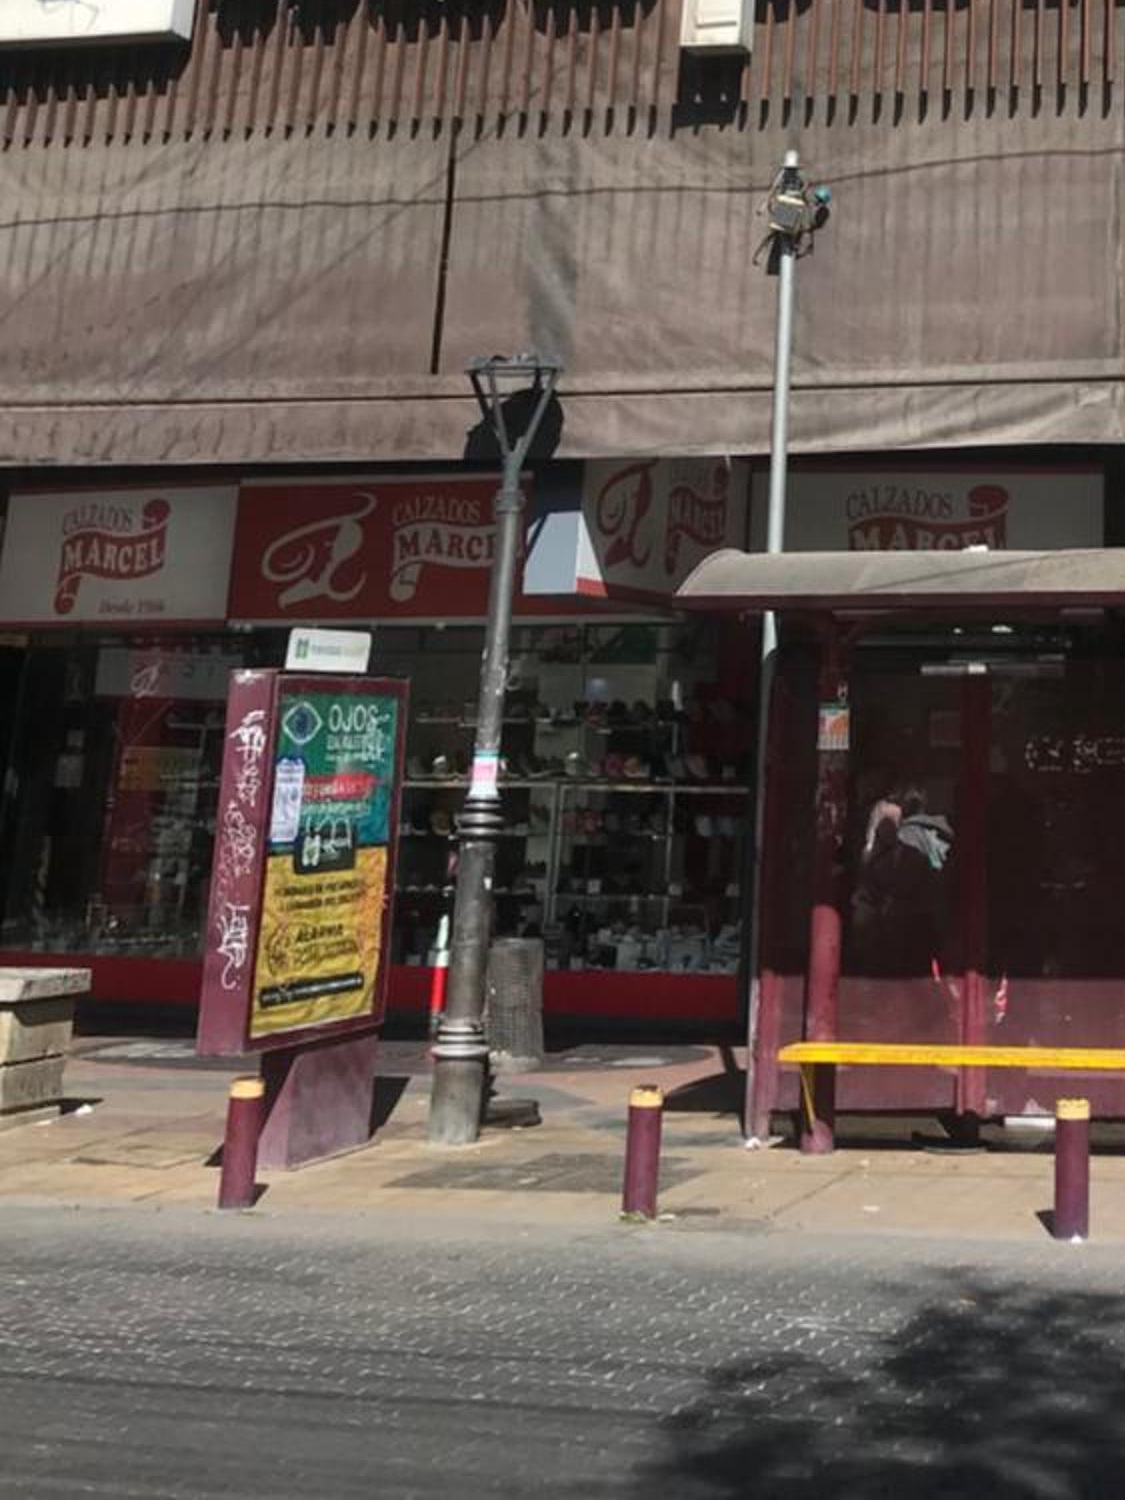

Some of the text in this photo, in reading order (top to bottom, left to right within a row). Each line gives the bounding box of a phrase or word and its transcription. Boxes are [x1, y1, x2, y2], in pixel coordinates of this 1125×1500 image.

[393, 496, 480, 526] CALZADOS
[846, 486, 952, 517] CALZADOS
[63, 537, 161, 573] MARCEL
[327, 704, 378, 733] OJOS
